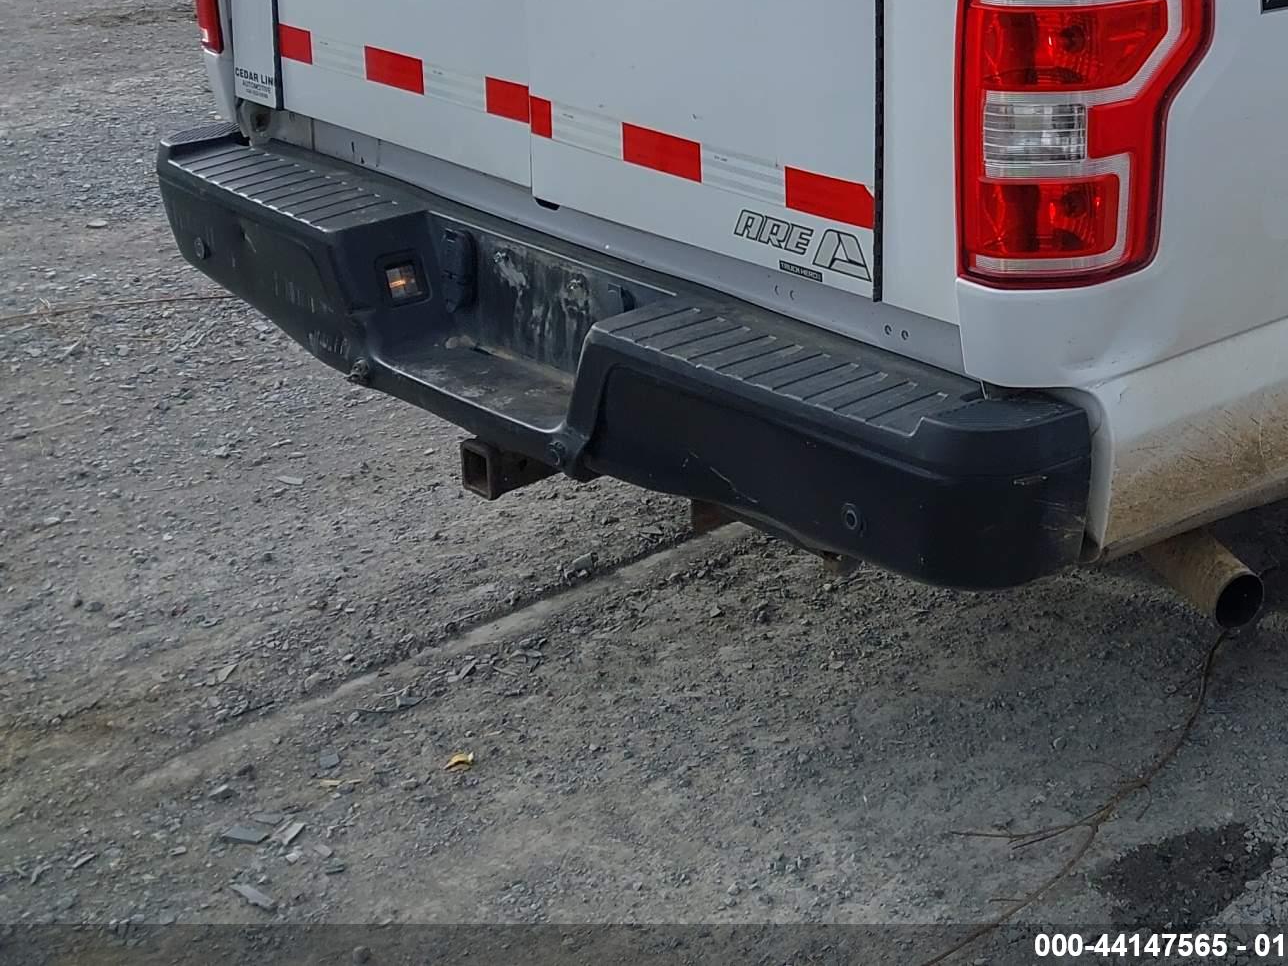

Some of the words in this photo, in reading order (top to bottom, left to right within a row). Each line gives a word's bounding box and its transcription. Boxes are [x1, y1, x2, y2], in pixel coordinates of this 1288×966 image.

[235, 67, 259, 83] CEDAR
[260, 73, 274, 86] LIN
[734, 209, 814, 256] ARE
